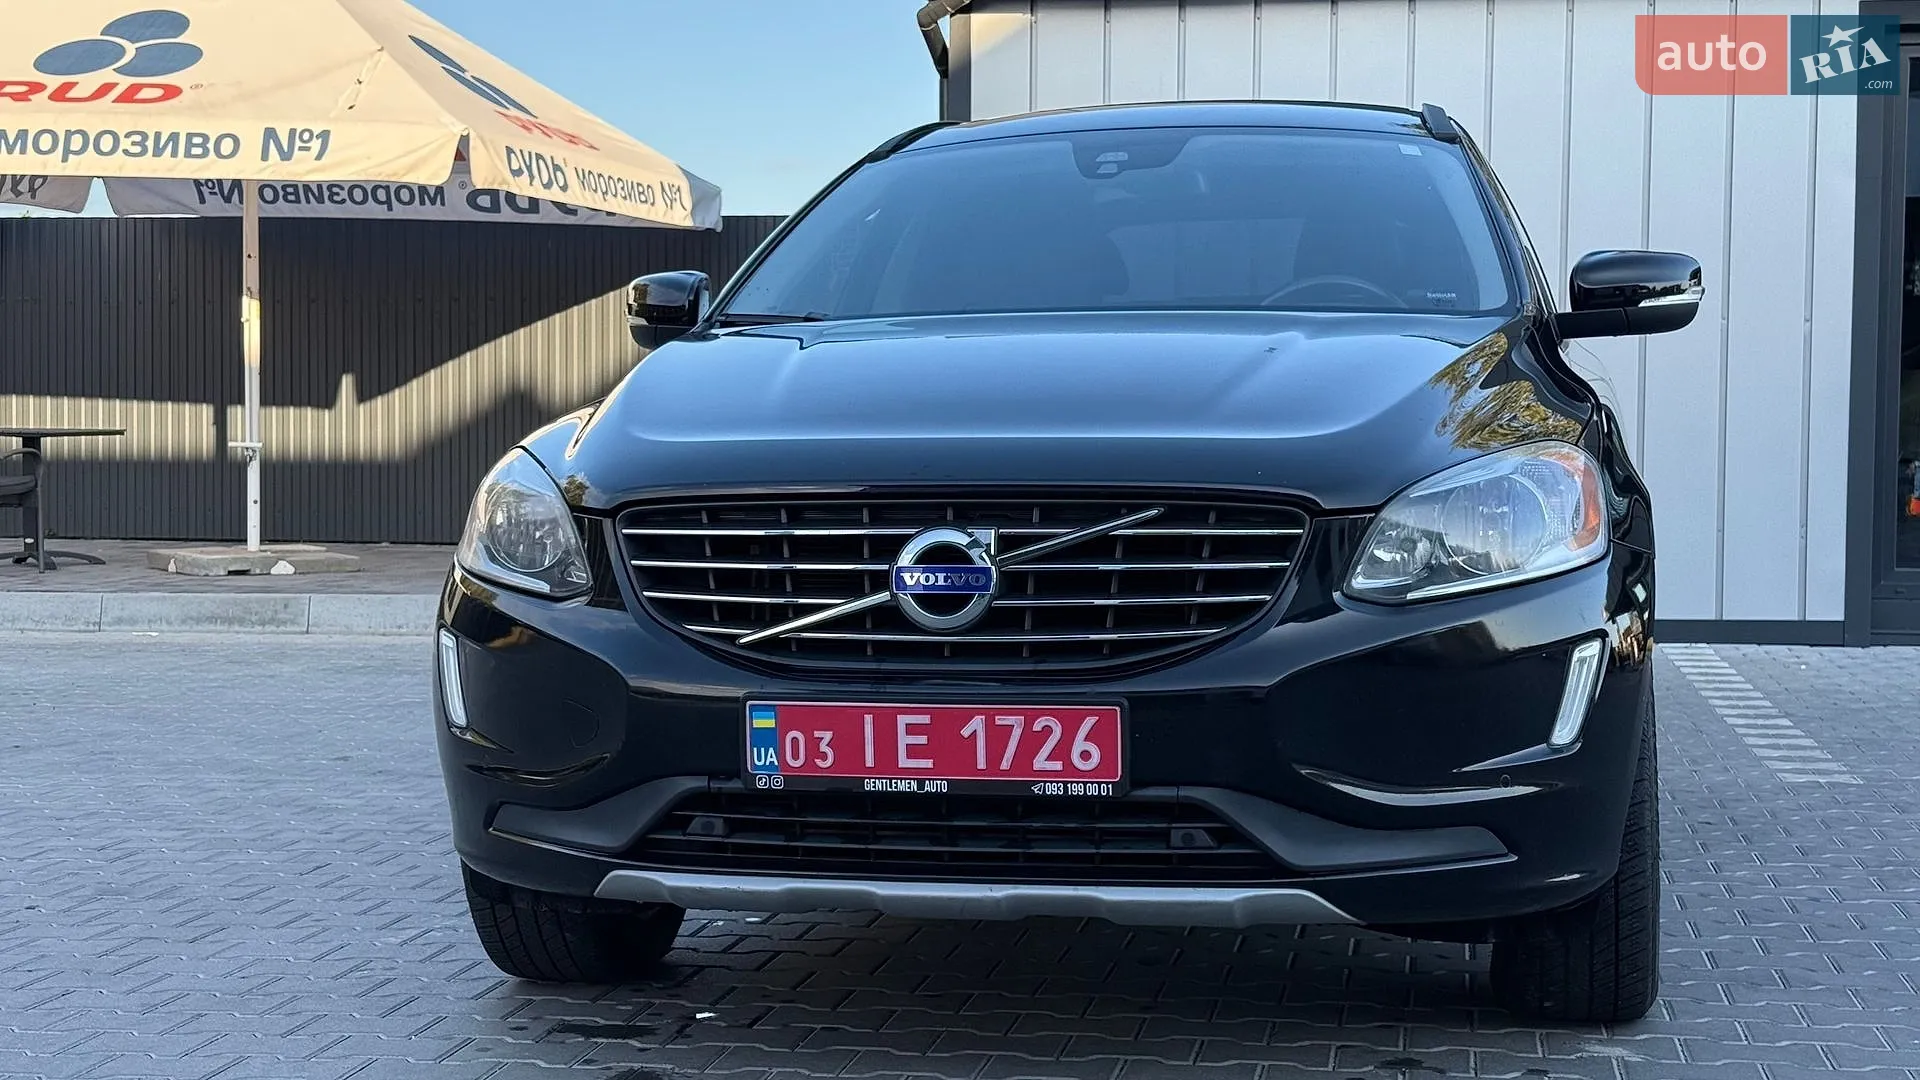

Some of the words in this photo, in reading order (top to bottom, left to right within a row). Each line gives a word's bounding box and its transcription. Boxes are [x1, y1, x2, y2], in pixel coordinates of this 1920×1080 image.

[0, 80, 183, 104] RUD
[0, 127, 241, 163] морозиво
[260, 126, 332, 162] №1
[574, 166, 656, 207] морозиво
[900, 572, 986, 587] VOLVO
[784, 730, 835, 769] 03
[960, 715, 1102, 772] 1726
[753, 746, 778, 766] UA
[864, 778, 948, 793] GENTLEMEN_AUTO
[1045, 782, 1064, 795] 093
[1067, 782, 1084, 796] 199
[1086, 783, 1099, 796] 00
[1101, 783, 1113, 796] 01
